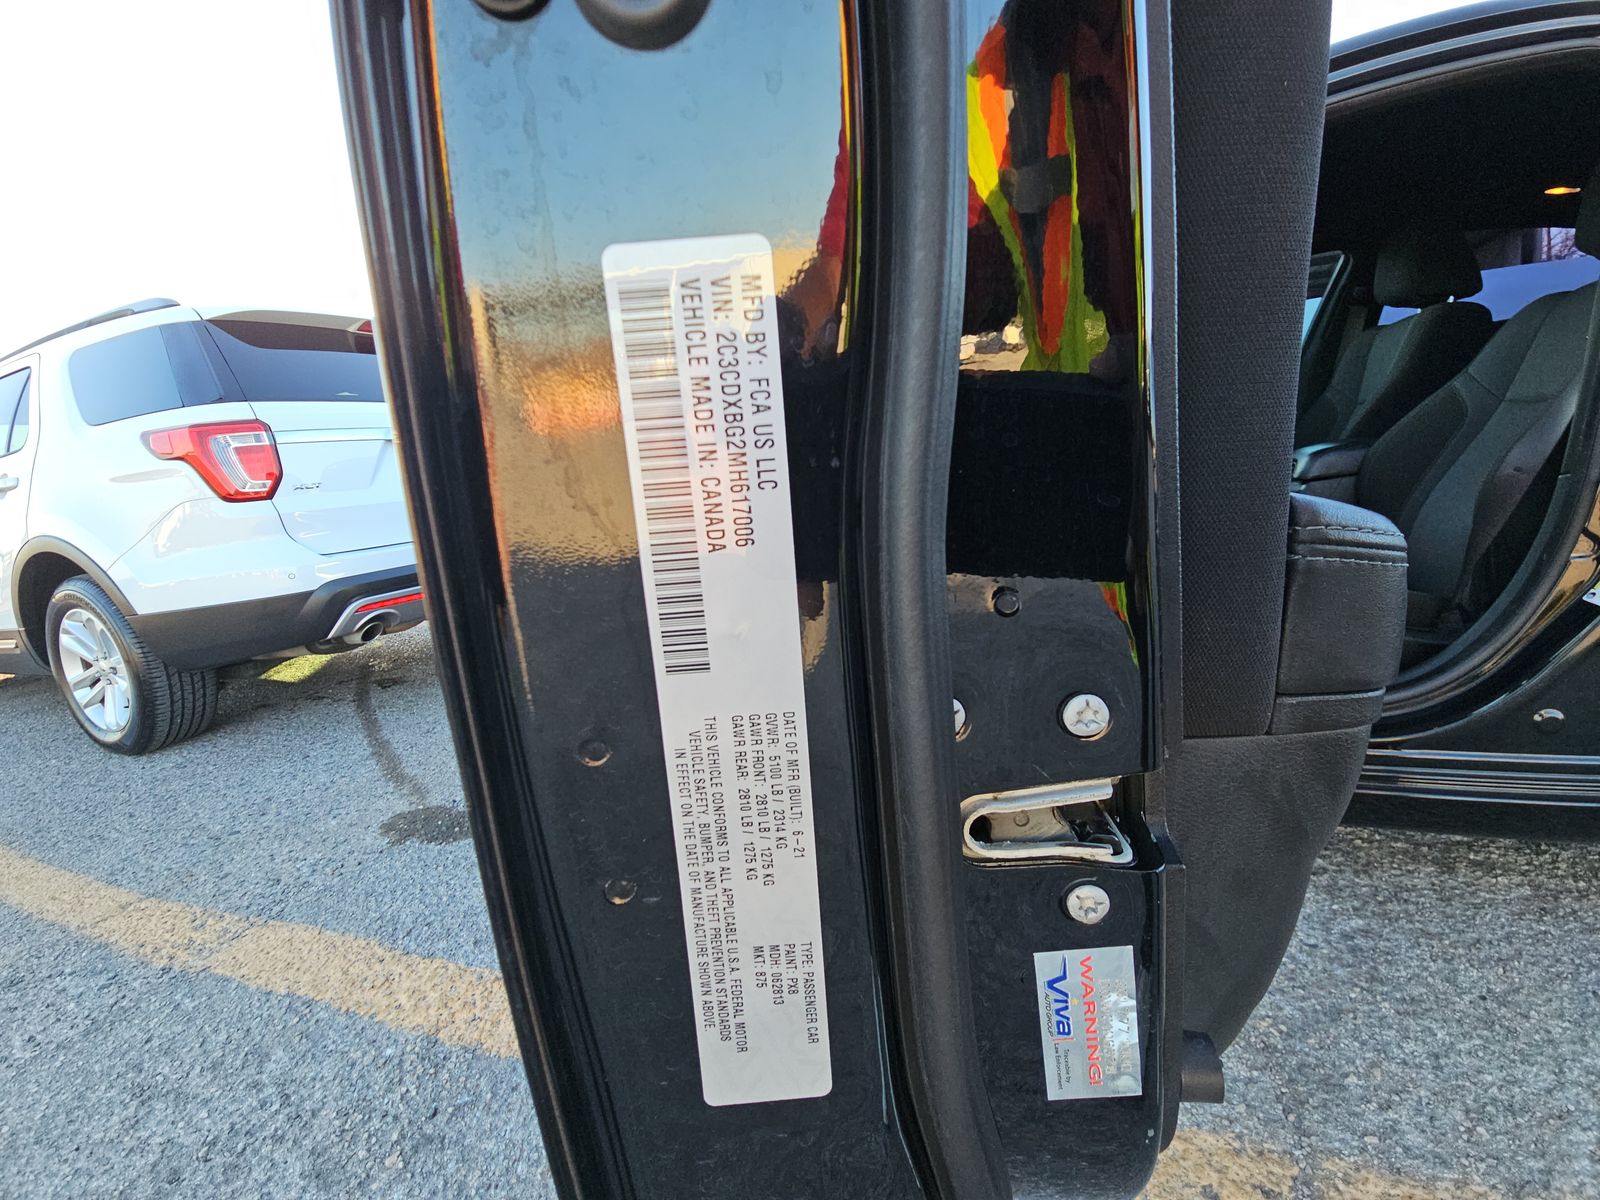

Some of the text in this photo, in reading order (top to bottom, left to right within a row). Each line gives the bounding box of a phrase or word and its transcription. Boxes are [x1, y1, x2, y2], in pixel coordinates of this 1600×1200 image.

[740, 274, 778, 490] MFD BY: FCA US LLC
[680, 277, 727, 554] VEHICLE MADE IN: CANADA
[710, 275, 755, 547] VIN: 2C3CDXBG2MH617006
[731, 714, 746, 747] GAWR
[748, 713, 763, 746] GAWR
[765, 712, 779, 748] GVWR:
[782, 711, 797, 738] DATE
[785, 741, 798, 755] OF
[734, 750, 749, 780] REAR:
[751, 749, 766, 787] FRONT:
[768, 755, 782, 779] 5100
[786, 759, 800, 781] MFR
[738, 788, 752, 811] 2810
[771, 783, 784, 796] LB
[786, 784, 803, 823] (BUILT):
[755, 793, 769, 817] 2810
[740, 815, 753, 827] LB
[758, 820, 770, 833] LB
[772, 809, 786, 832] 2314
[743, 841, 757, 864] 1275
[775, 836, 788, 849] KG
[746, 867, 758, 880] KG
[760, 847, 774, 870] 1275
[674, 748, 716, 1031] IN EFFECT ON THE DATE OF MANUFACTURE SHOWN ABOVE.
[688, 730, 732, 1042] VEHICLE SAFETY, BUMPER, AND THEFT PREVENTION STANDARDS
[704, 716, 748, 1053] THIS VEHICLE CONFORMS TO ALL APPLICABLE U.S.A. FEDERAL MOTOR
[762, 873, 775, 886] KG
[752, 945, 768, 988] MKT: 875
[768, 944, 784, 1005] MDH: 062813
[784, 943, 799, 995] PAINT: PX8
[800, 941, 819, 1044] TYPE: PASSENGER CAR
[1046, 1012, 1054, 1038] GROUP
[1054, 1055, 1064, 1090] Enforcement
